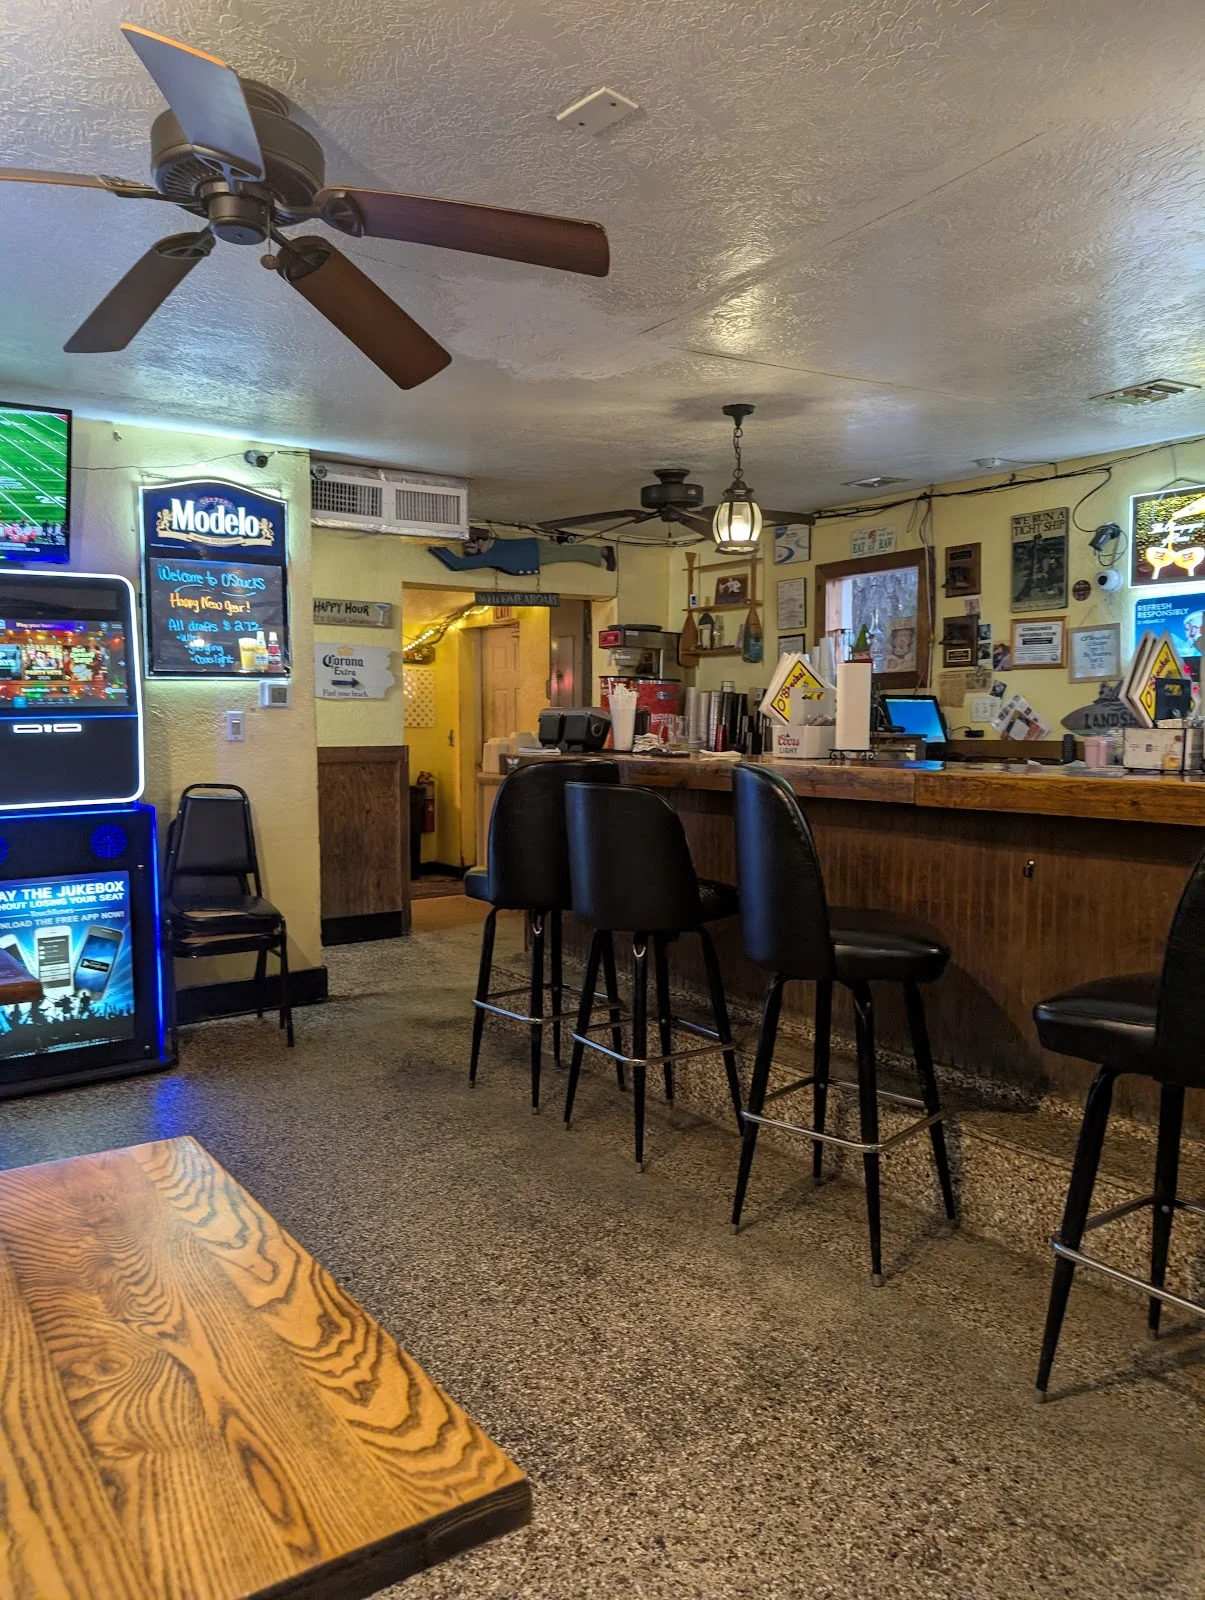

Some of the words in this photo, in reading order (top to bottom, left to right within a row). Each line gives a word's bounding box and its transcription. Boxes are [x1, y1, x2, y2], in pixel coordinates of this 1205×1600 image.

[171, 498, 259, 537] Modelo
[1014, 516, 1030, 525] WE
[1032, 512, 1054, 523] RUN
[1058, 511, 1065, 519] A
[1013, 523, 1042, 536] TIGHT
[1044, 520, 1065, 531] SHIP
[157, 565, 204, 584] Welcome
[205, 571, 218, 586] to
[169, 593, 200, 614] Happy
[201, 596, 223, 610] New
[478, 593, 521, 605] WELCOME
[314, 600, 343, 613] HAPPY
[345, 602, 370, 616] HOUR
[1137, 603, 1172, 611] REFRESH
[1137, 608, 1189, 619] RESPONSIBLY
[168, 619, 184, 631] All
[188, 620, 219, 632] drafts
[322, 654, 364, 669] Corona
[334, 667, 356, 676] Extra
[777, 734, 800, 746] Coors
[21, 887, 53, 900] THE
[56, 880, 125, 898] JUKEBOX
[30, 898, 68, 908] LOSING
[69, 895, 97, 904] YOUR
[99, 892, 124, 901] SEAT
[34, 917, 54, 926] THE
[55, 915, 79, 924] FREE
[81, 913, 100, 921] APP
[100, 911, 125, 919] NOW!
